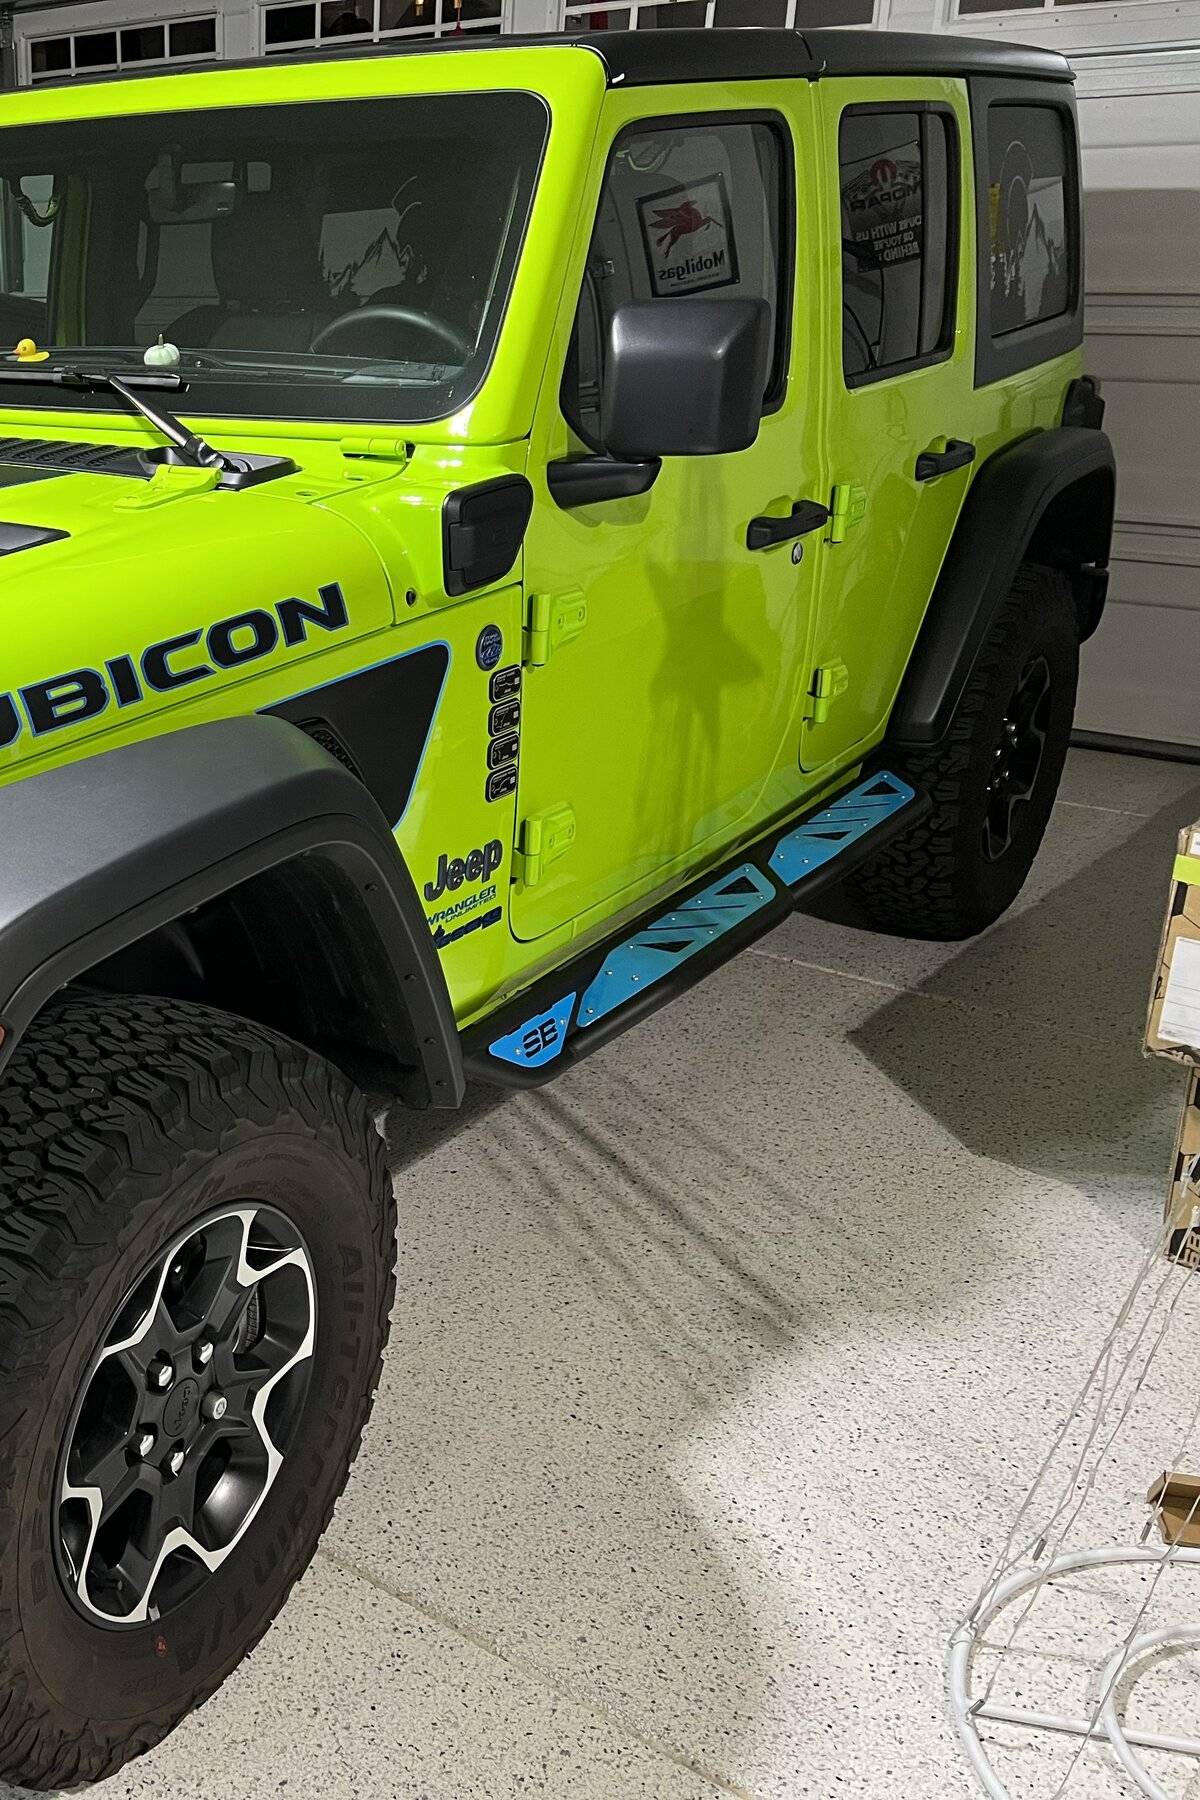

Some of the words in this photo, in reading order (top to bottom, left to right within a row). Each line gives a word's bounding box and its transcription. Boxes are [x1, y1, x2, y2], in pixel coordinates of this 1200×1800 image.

[423, 839, 503, 902] Jeep
[426, 885, 497, 926] WRANGLER
[445, 895, 497, 924] UNLIMITED
